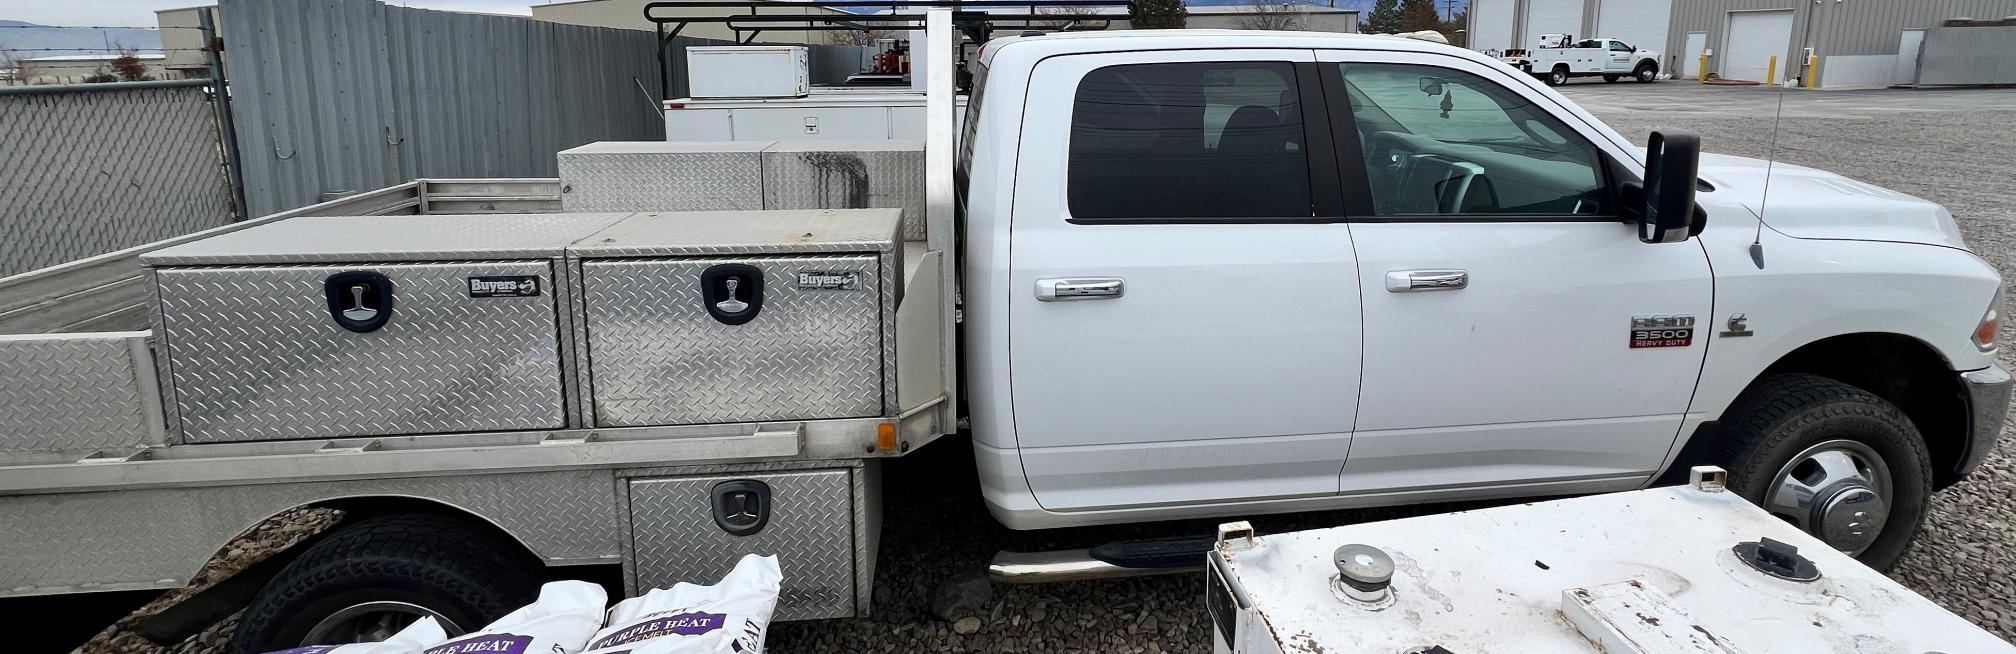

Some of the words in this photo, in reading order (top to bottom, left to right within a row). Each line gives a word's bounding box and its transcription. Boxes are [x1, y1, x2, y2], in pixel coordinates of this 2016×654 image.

[470, 279, 517, 293] Buyers
[797, 273, 842, 287] Buyers
[1635, 329, 1689, 340] 3500
[597, 621, 660, 649] PURPLE
[663, 617, 711, 630] HEAT
[460, 640, 515, 653] HEAT
